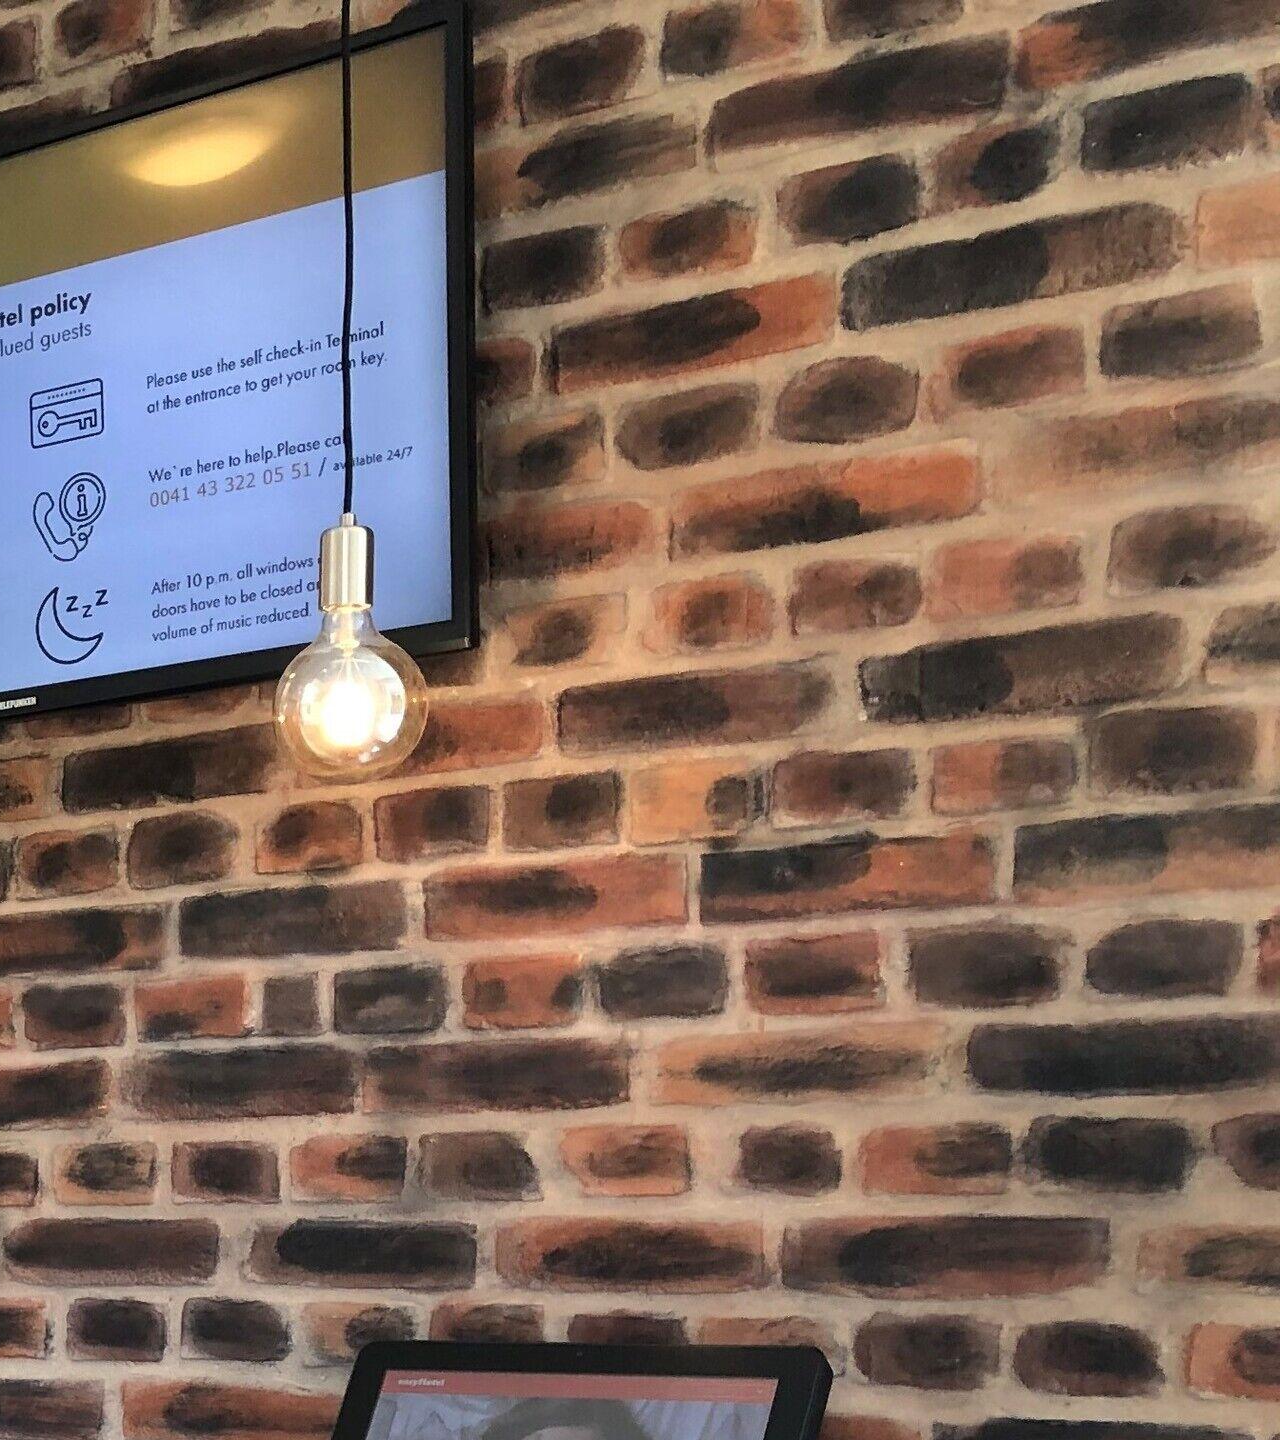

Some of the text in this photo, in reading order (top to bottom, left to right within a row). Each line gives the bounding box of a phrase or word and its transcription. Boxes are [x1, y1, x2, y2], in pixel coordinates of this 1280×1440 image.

[30, 292, 92, 327] policy
[40, 322, 92, 352] guests
[146, 320, 384, 389] Please use the self check-in Teminal
[147, 400, 159, 414] at
[162, 394, 181, 410] the
[185, 384, 241, 406] entrance
[245, 379, 258, 392] to
[261, 372, 283, 392] get
[286, 367, 317, 387] your
[360, 350, 388, 367] key.
[149, 486, 190, 507] 0041
[197, 480, 218, 497] 43
[224, 472, 256, 493] 322
[262, 466, 284, 485] 05
[291, 461, 311, 480] 51
[386, 446, 413, 462] 24/7
[197, 459, 225, 475] here
[228, 455, 241, 468] to
[151, 578, 181, 595] After
[187, 572, 202, 588] 10
[236, 563, 253, 580] all
[256, 556, 314, 576] windows
[152, 603, 187, 619] doors
[190, 597, 221, 612] have
[224, 594, 237, 606] to
[240, 588, 257, 603] be
[260, 578, 303, 600] closed
[152, 625, 197, 642] volume
[200, 617, 214, 634] of
[216, 614, 252, 632] music
